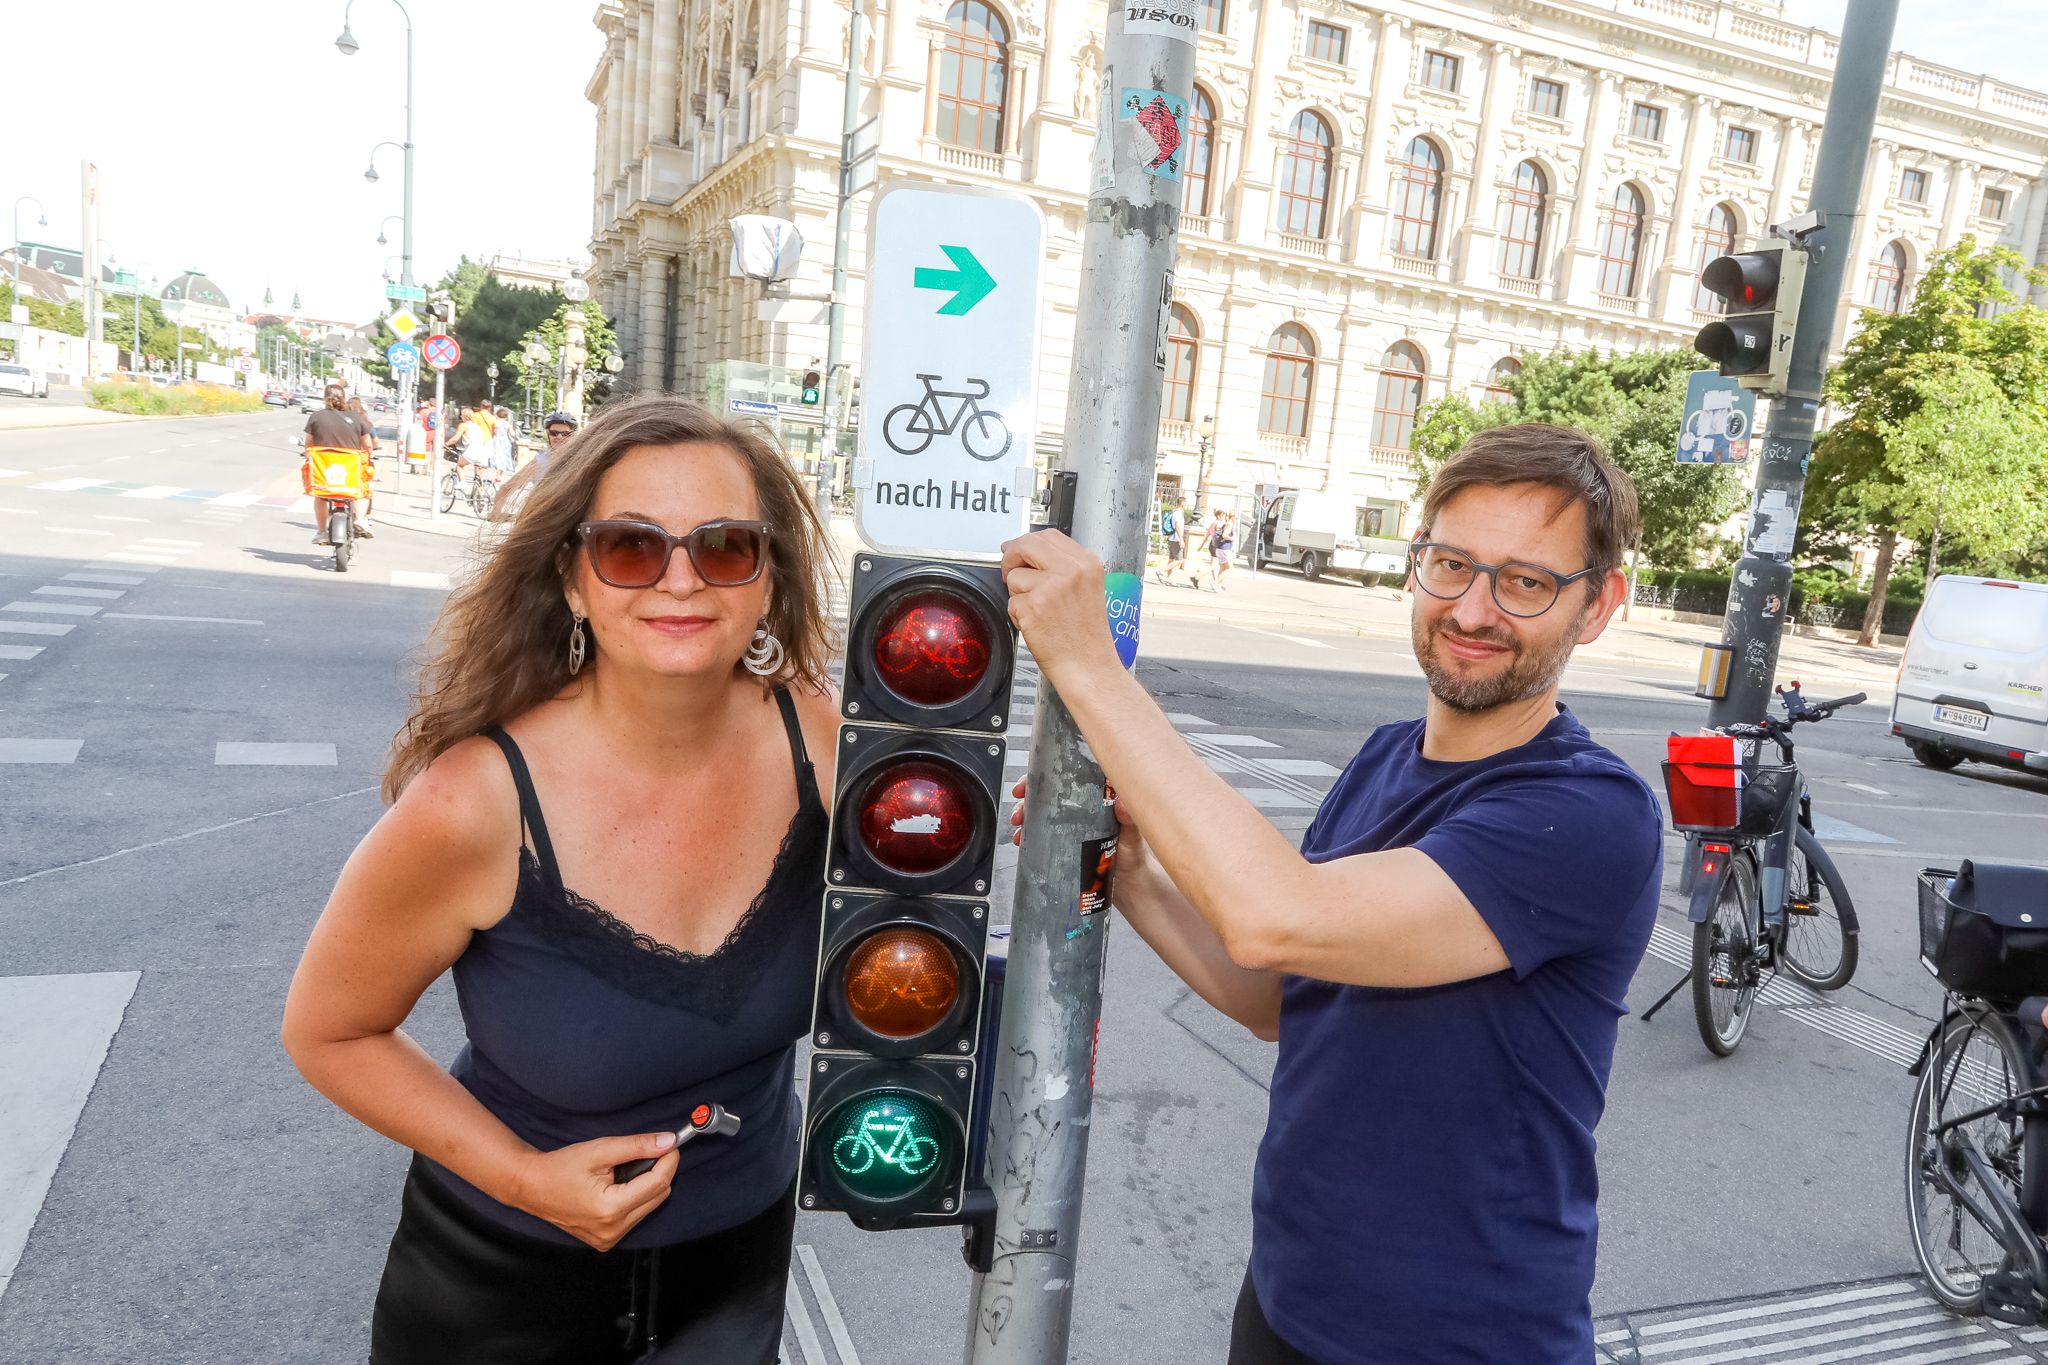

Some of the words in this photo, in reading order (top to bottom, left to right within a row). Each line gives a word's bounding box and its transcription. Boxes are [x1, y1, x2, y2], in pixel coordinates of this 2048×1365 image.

[876, 478, 942, 509] nach
[950, 480, 1011, 514] Halt
[1036, 1233, 1044, 1245] 6
